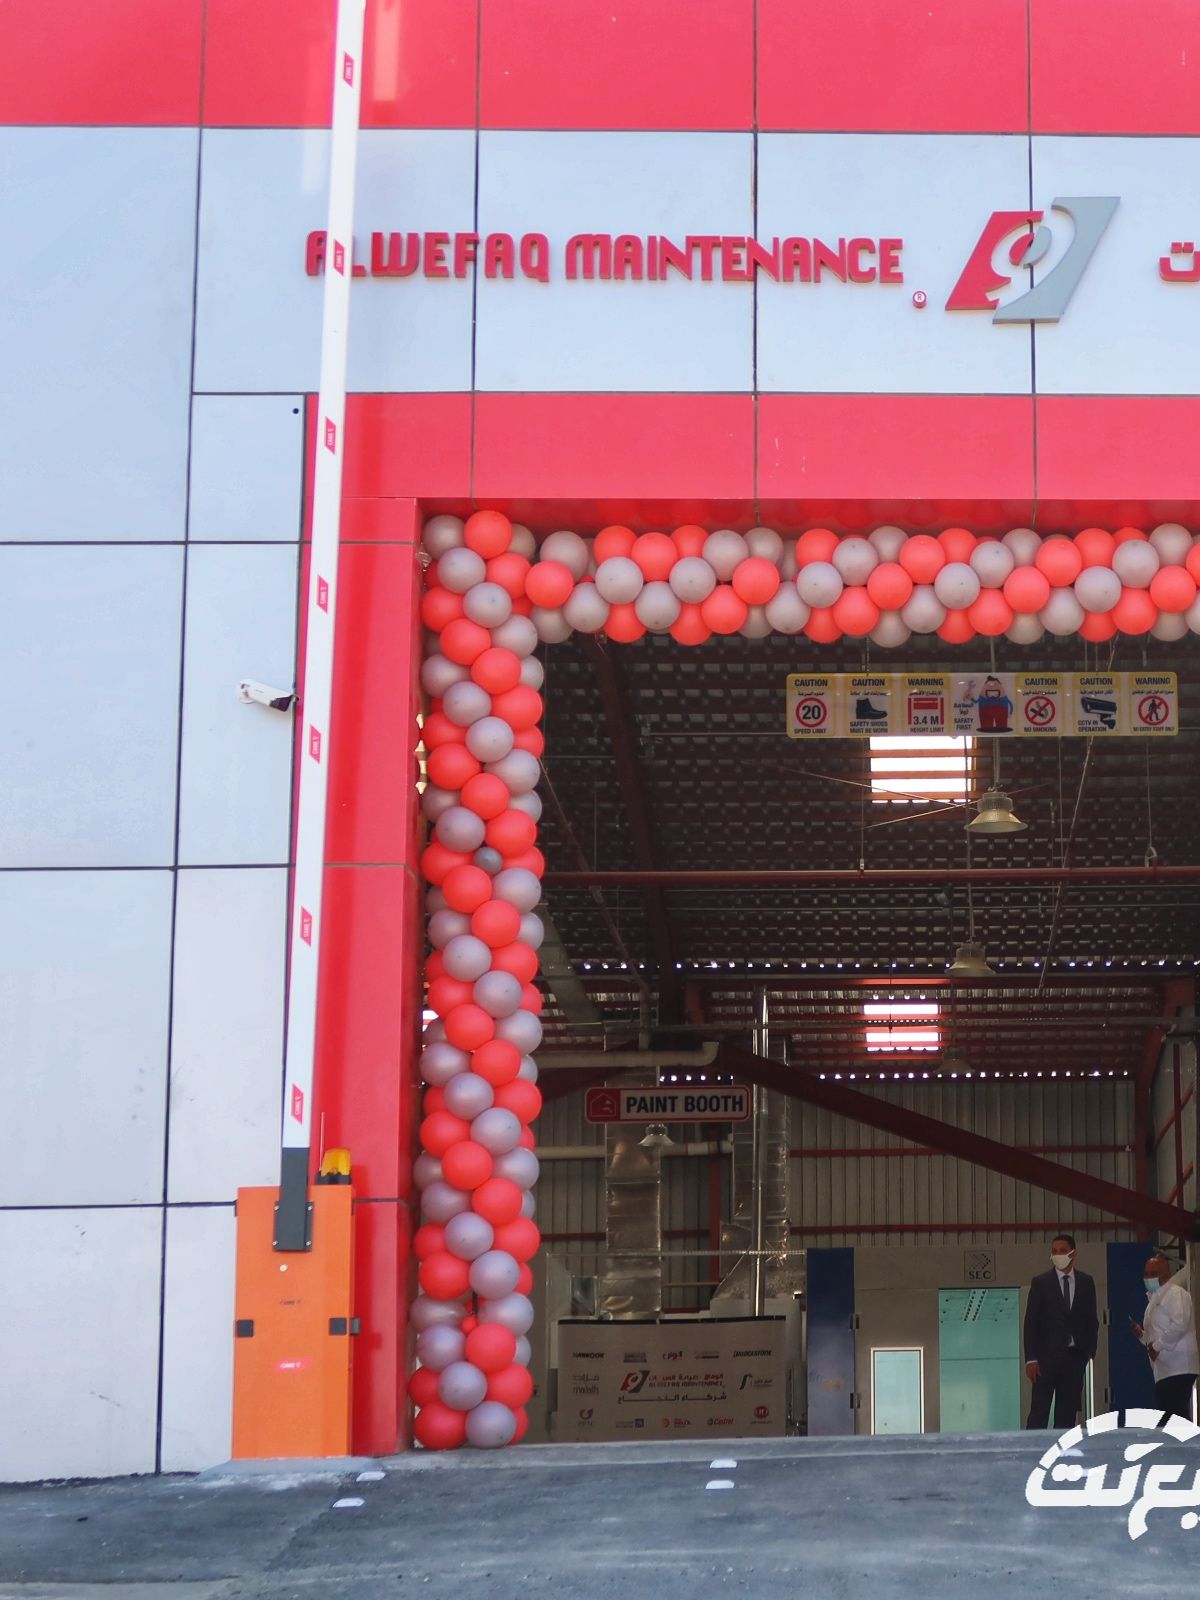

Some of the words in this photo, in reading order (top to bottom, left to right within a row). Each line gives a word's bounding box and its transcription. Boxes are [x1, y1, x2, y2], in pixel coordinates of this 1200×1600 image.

[565, 233, 904, 284] MAINTENANCE
[794, 679, 828, 687] CAUTION
[851, 679, 885, 687] CAUTION
[907, 678, 944, 686] WARNING
[1024, 678, 1058, 686] CAUTION
[1080, 678, 1113, 686] CAUTION
[1135, 677, 1170, 685] WARNING
[802, 705, 821, 720] 20
[913, 716, 927, 725] 3.4
[930, 716, 939, 725] M
[625, 1096, 677, 1114] PAINT
[684, 1095, 744, 1113] BOOTH
[968, 1270, 992, 1280] SEC
[733, 1349, 772, 1358] BRIDGESTONE
